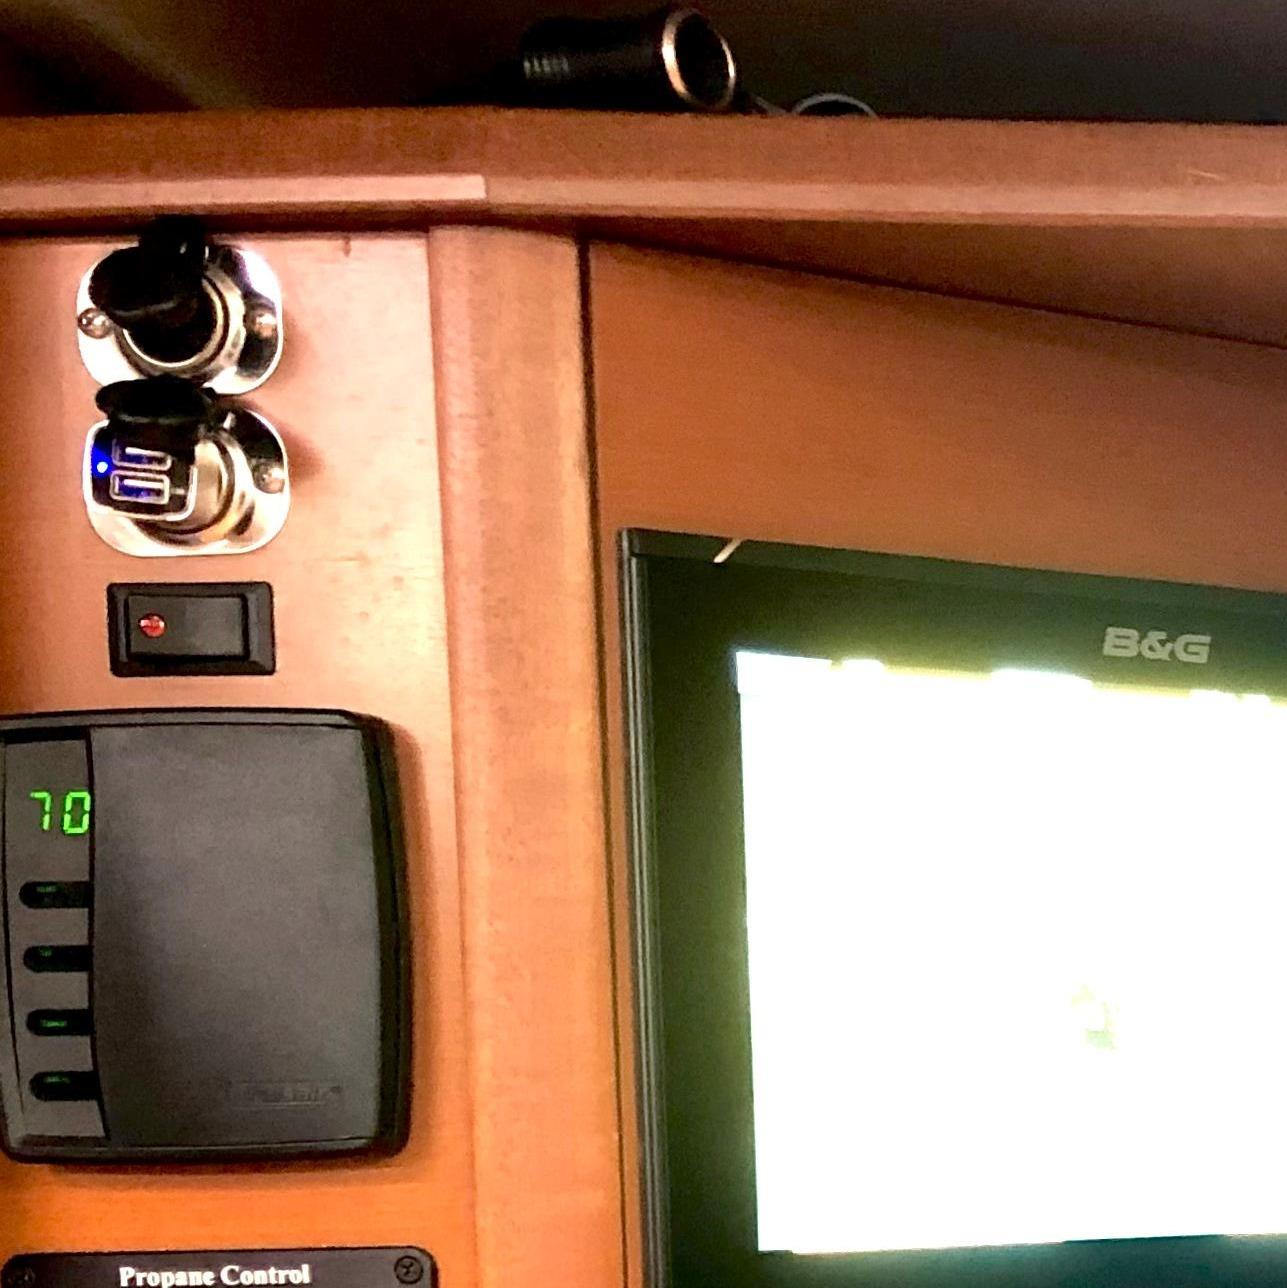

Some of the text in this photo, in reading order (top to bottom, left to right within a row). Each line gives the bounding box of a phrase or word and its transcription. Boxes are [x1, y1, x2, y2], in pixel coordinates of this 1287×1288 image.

[1102, 626, 1211, 665] B&G
[29, 791, 91, 836] 70
[220, 1263, 311, 1287] Control
